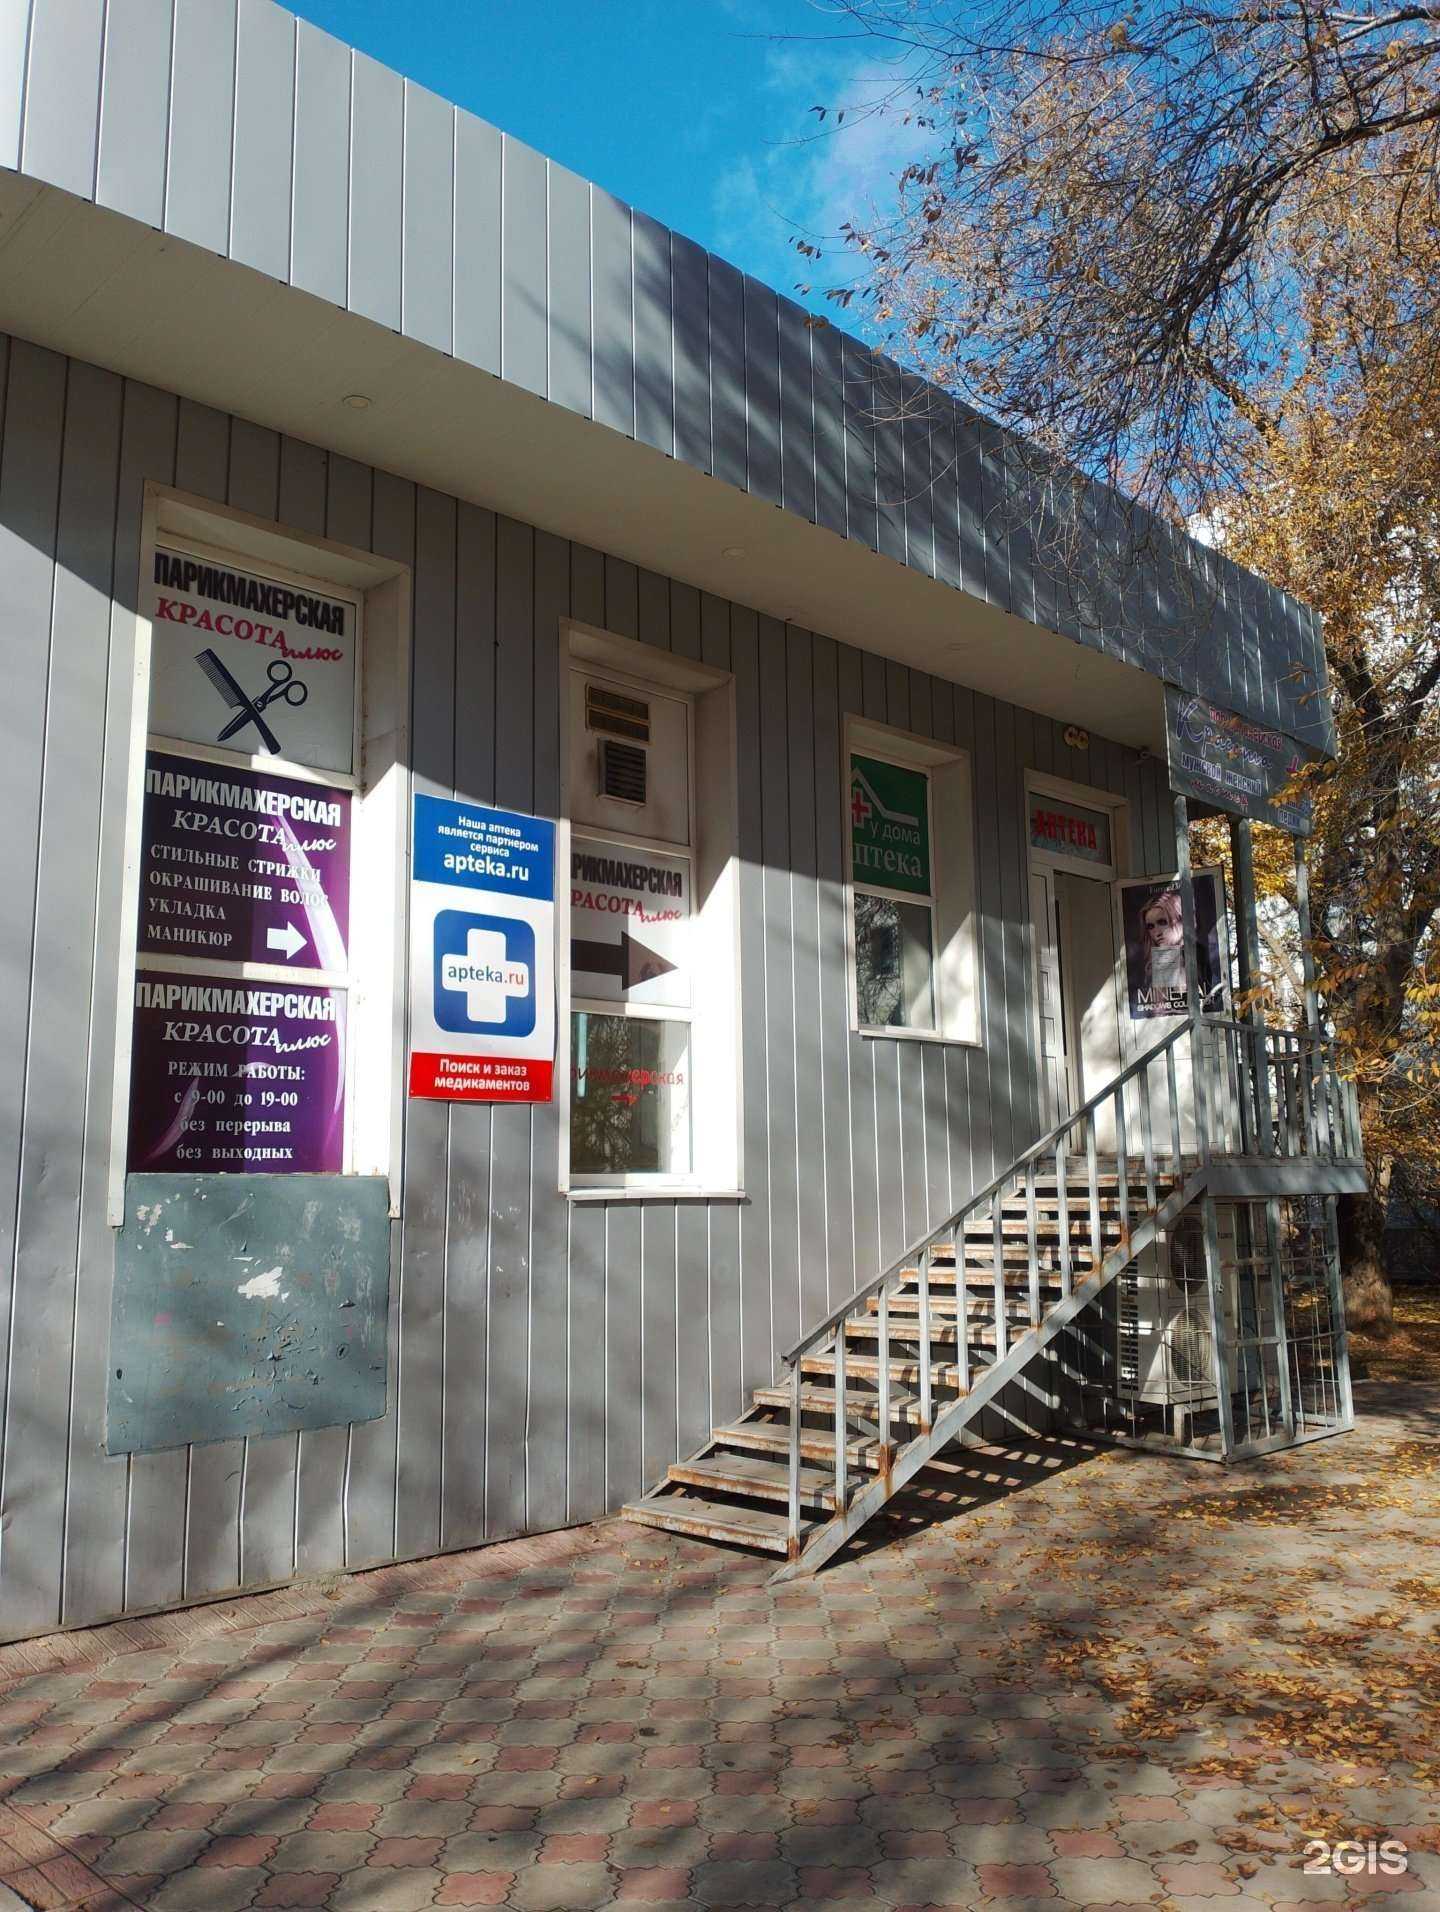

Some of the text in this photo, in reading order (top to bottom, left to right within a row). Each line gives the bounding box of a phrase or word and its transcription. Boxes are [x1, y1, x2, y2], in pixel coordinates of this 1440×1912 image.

[153, 551, 345, 636] ПАРИКМАХЕРСКАЯ
[154, 596, 288, 650] КРАСОТА
[145, 768, 342, 828] ПАРИКМАХЕРСКАЯ
[172, 809, 286, 846] КРАСОТА
[437, 825, 540, 853] является партнером
[457, 815, 522, 838] Наша аптека
[882, 824, 921, 845] дома
[150, 844, 322, 883] СТИЛЬНЫЕ СТРИЖКИ
[469, 842, 511, 858] сервиса
[852, 842, 924, 879] птека
[443, 851, 530, 882] apteka.ru
[571, 852, 683, 898] РИКМАХЕРСКАЯ
[149, 870, 273, 901] ОКРАШИВАНИЕ
[148, 897, 227, 921] УКЛАДКА
[570, 888, 644, 917] РАСОТА
[146, 924, 233, 948] МАНИКЮР
[447, 963, 525, 987] apteka.ru
[135, 982, 337, 1022] ПАРИКМАХЕРСКАЯ
[162, 1021, 280, 1048] КРАСОТА
[167, 1061, 306, 1081] РЕЖИМ РАБОТЫ:
[439, 1058, 528, 1077] Поиск и заказ
[174, 1089, 299, 1107] с 9-00 до 19-00
[434, 1077, 530, 1093] медикаментов
[180, 1116, 292, 1137] без перерыва
[176, 1143, 294, 1162] без выходных
